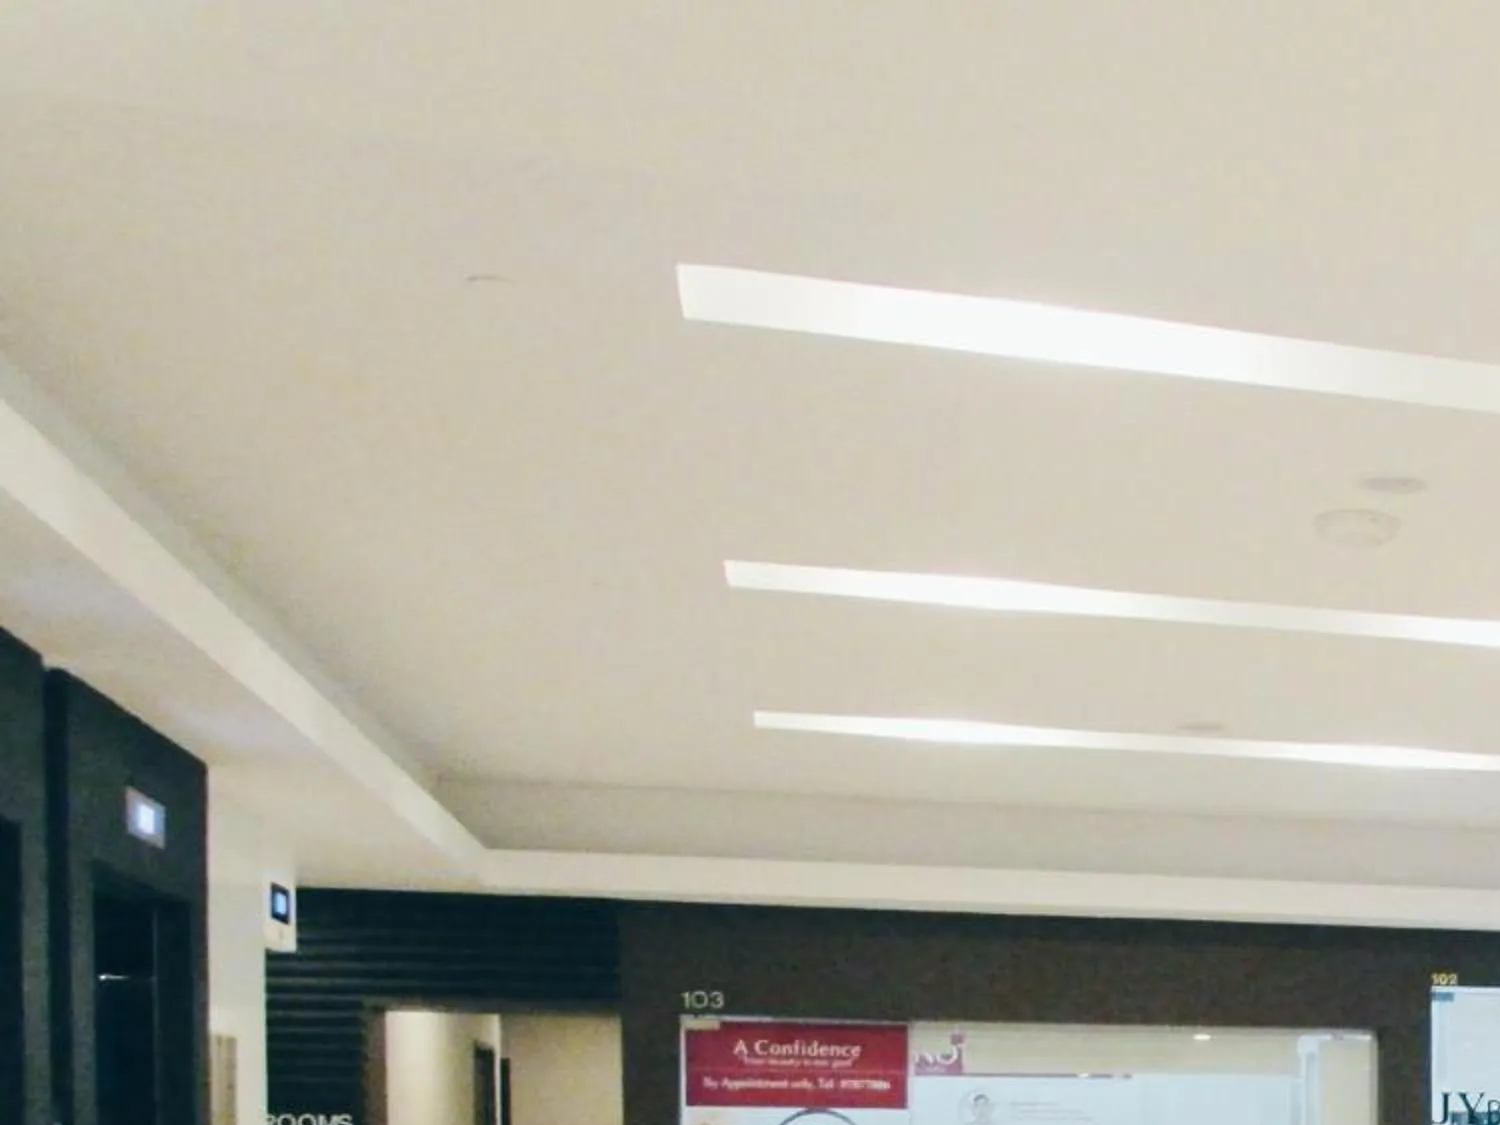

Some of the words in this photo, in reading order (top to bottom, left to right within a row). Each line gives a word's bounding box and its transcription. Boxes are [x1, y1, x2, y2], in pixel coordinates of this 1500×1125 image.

[680, 991, 724, 1009] 103
[733, 1039, 749, 1056] A
[754, 1038, 862, 1058] Confidence
